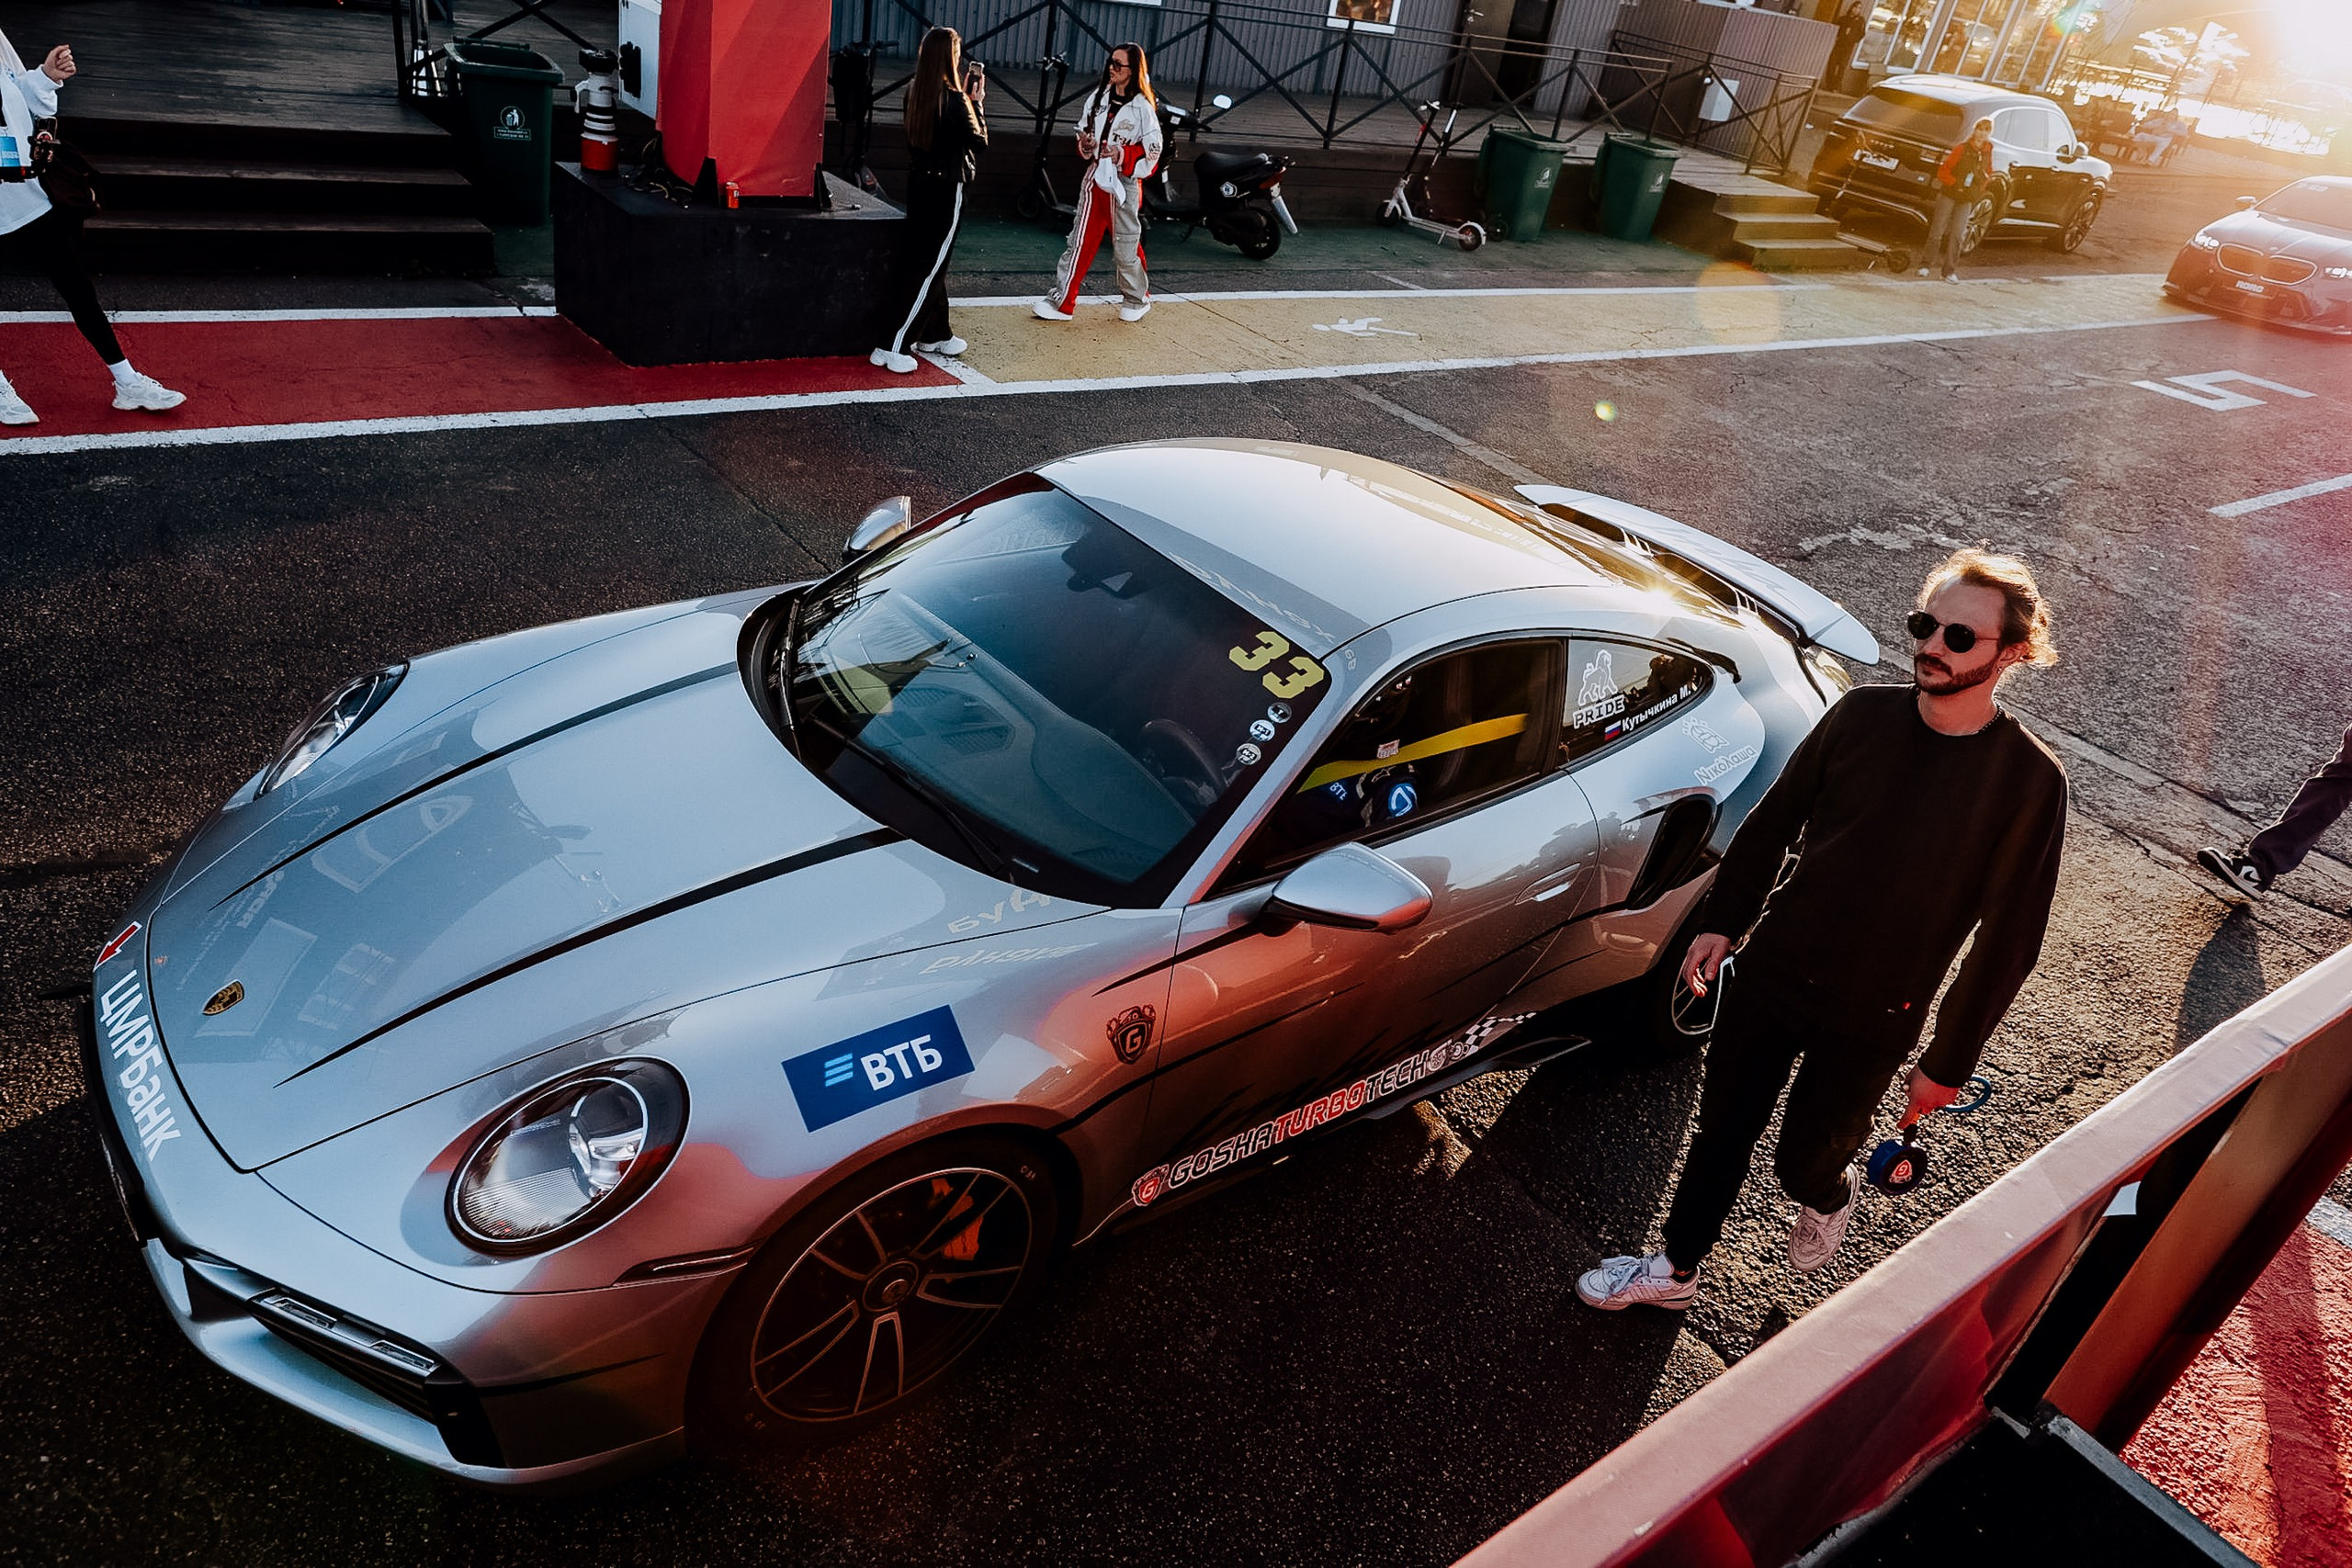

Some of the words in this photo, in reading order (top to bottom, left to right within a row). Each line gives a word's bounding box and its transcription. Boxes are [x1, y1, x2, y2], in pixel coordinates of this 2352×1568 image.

[2129, 369, 2319, 412] 5
[1228, 630, 1325, 699] 33
[1573, 694, 1624, 728] PRIDE
[1622, 694, 1678, 732] Кутычкина
[860, 1034, 943, 1091] ВТБ
